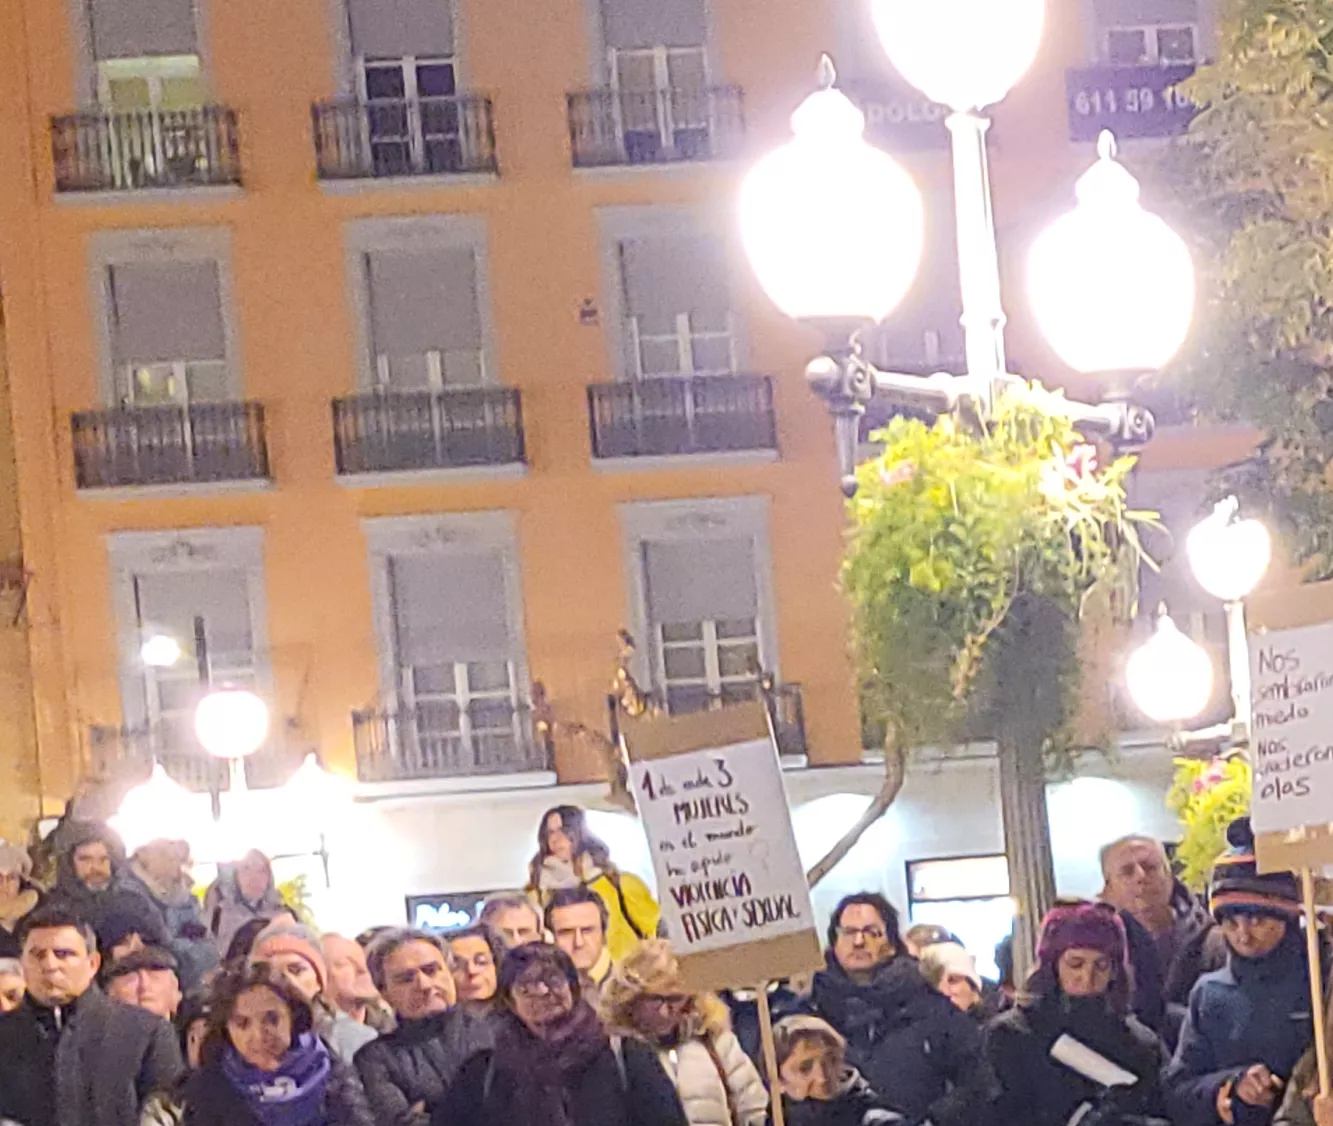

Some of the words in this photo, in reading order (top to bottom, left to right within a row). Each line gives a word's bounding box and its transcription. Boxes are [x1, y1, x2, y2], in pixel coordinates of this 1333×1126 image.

[641, 769, 657, 801] 1
[713, 758, 734, 789] 3
[673, 791, 750, 826] MUJERES
[669, 872, 753, 909] VIOLENCIA
[741, 893, 802, 928] SEXUAL
